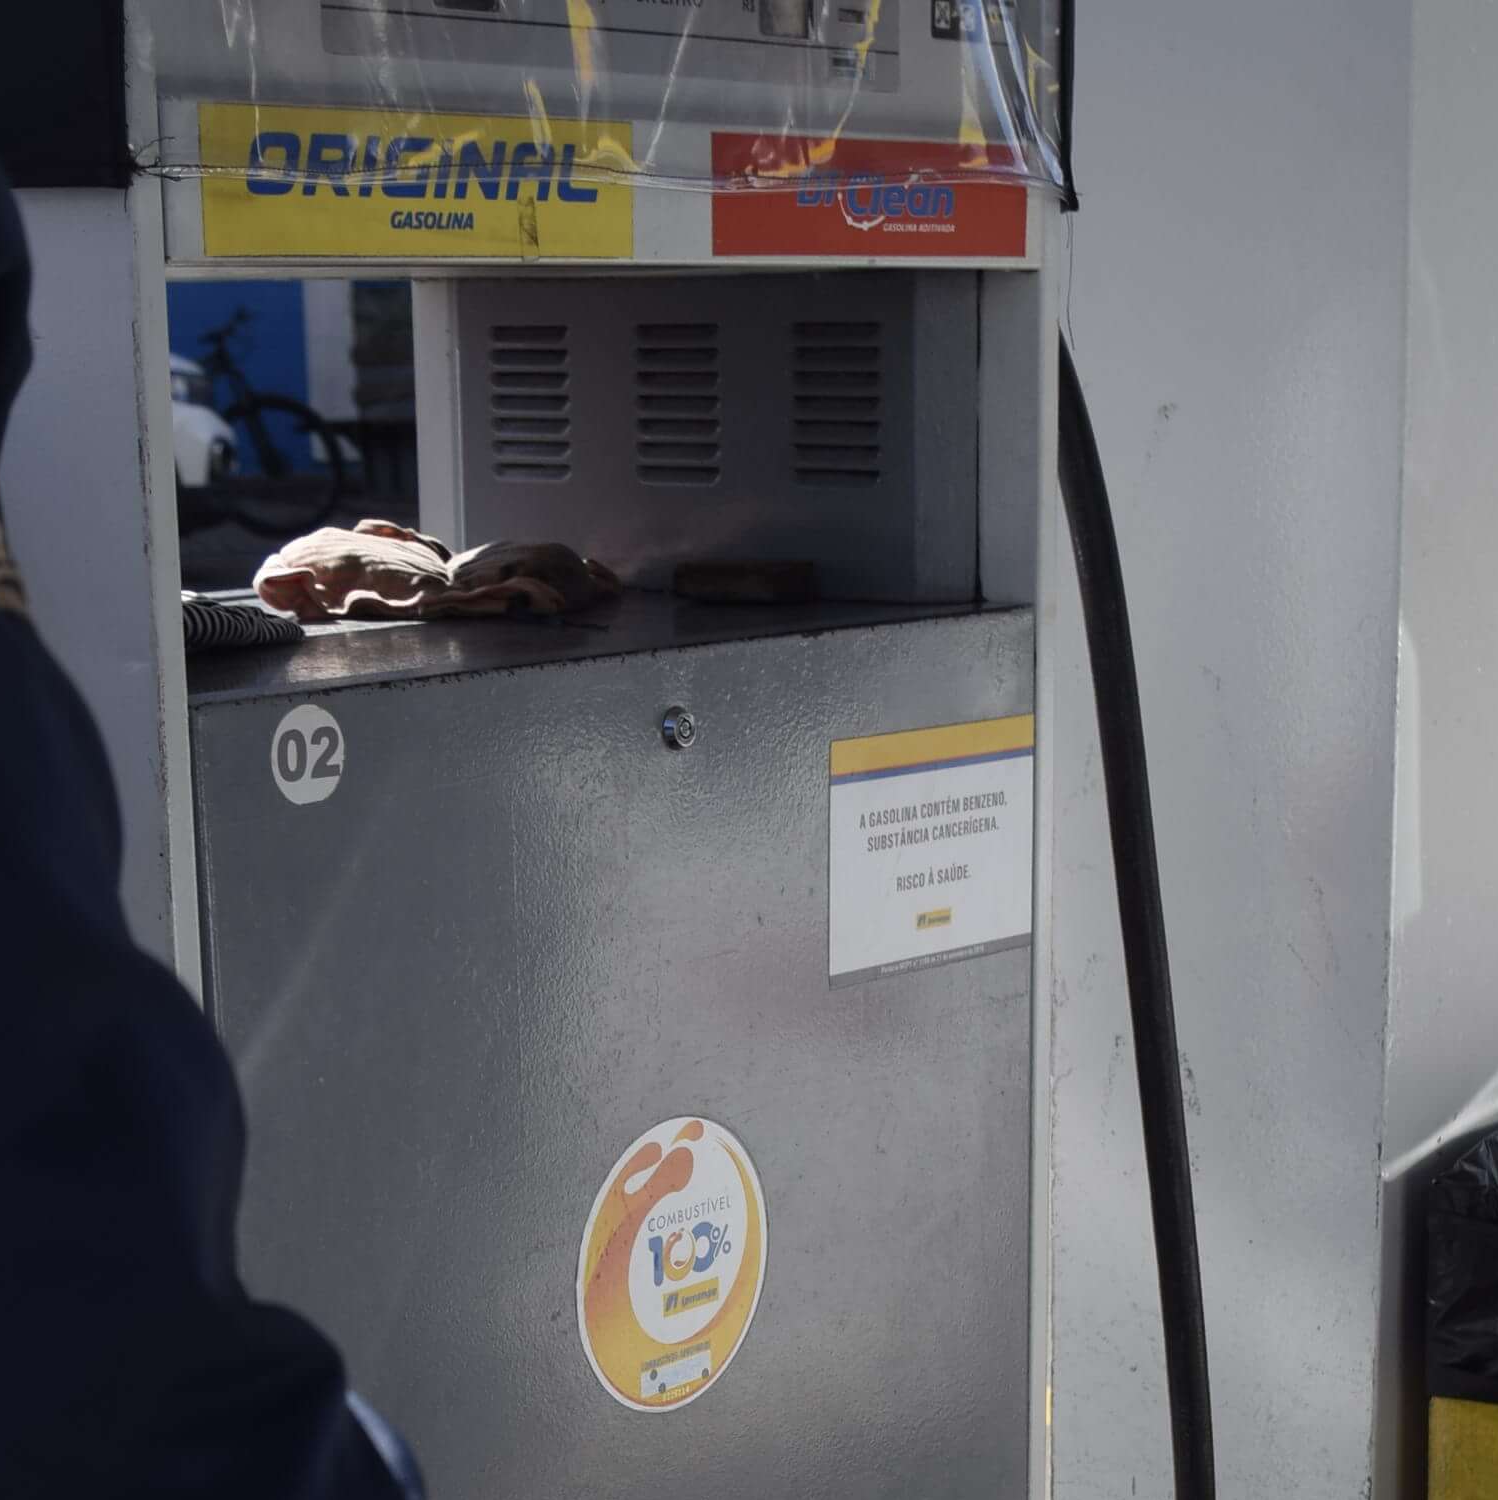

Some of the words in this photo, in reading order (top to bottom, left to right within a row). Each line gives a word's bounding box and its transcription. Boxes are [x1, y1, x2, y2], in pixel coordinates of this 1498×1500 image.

[246, 131, 599, 203] ORIGINAL
[845, 172, 956, 219] Clean
[390, 210, 475, 231] GASOLINA
[882, 223, 917, 233] GASOLINA
[277, 726, 341, 782] 02
[859, 814, 866, 829] A
[869, 805, 918, 828] GASOLINA
[920, 795, 960, 819] CONTÉM
[867, 827, 929, 852] SUBSTÂNCIA
[932, 815, 999, 840] CANCERÍGENA.
[896, 872, 925, 892] RISCO
[937, 863, 971, 884] SAÚDE.
[647, 1196, 732, 1233] COMBUSTÍVEL
[648, 1220, 732, 1288] 100%
